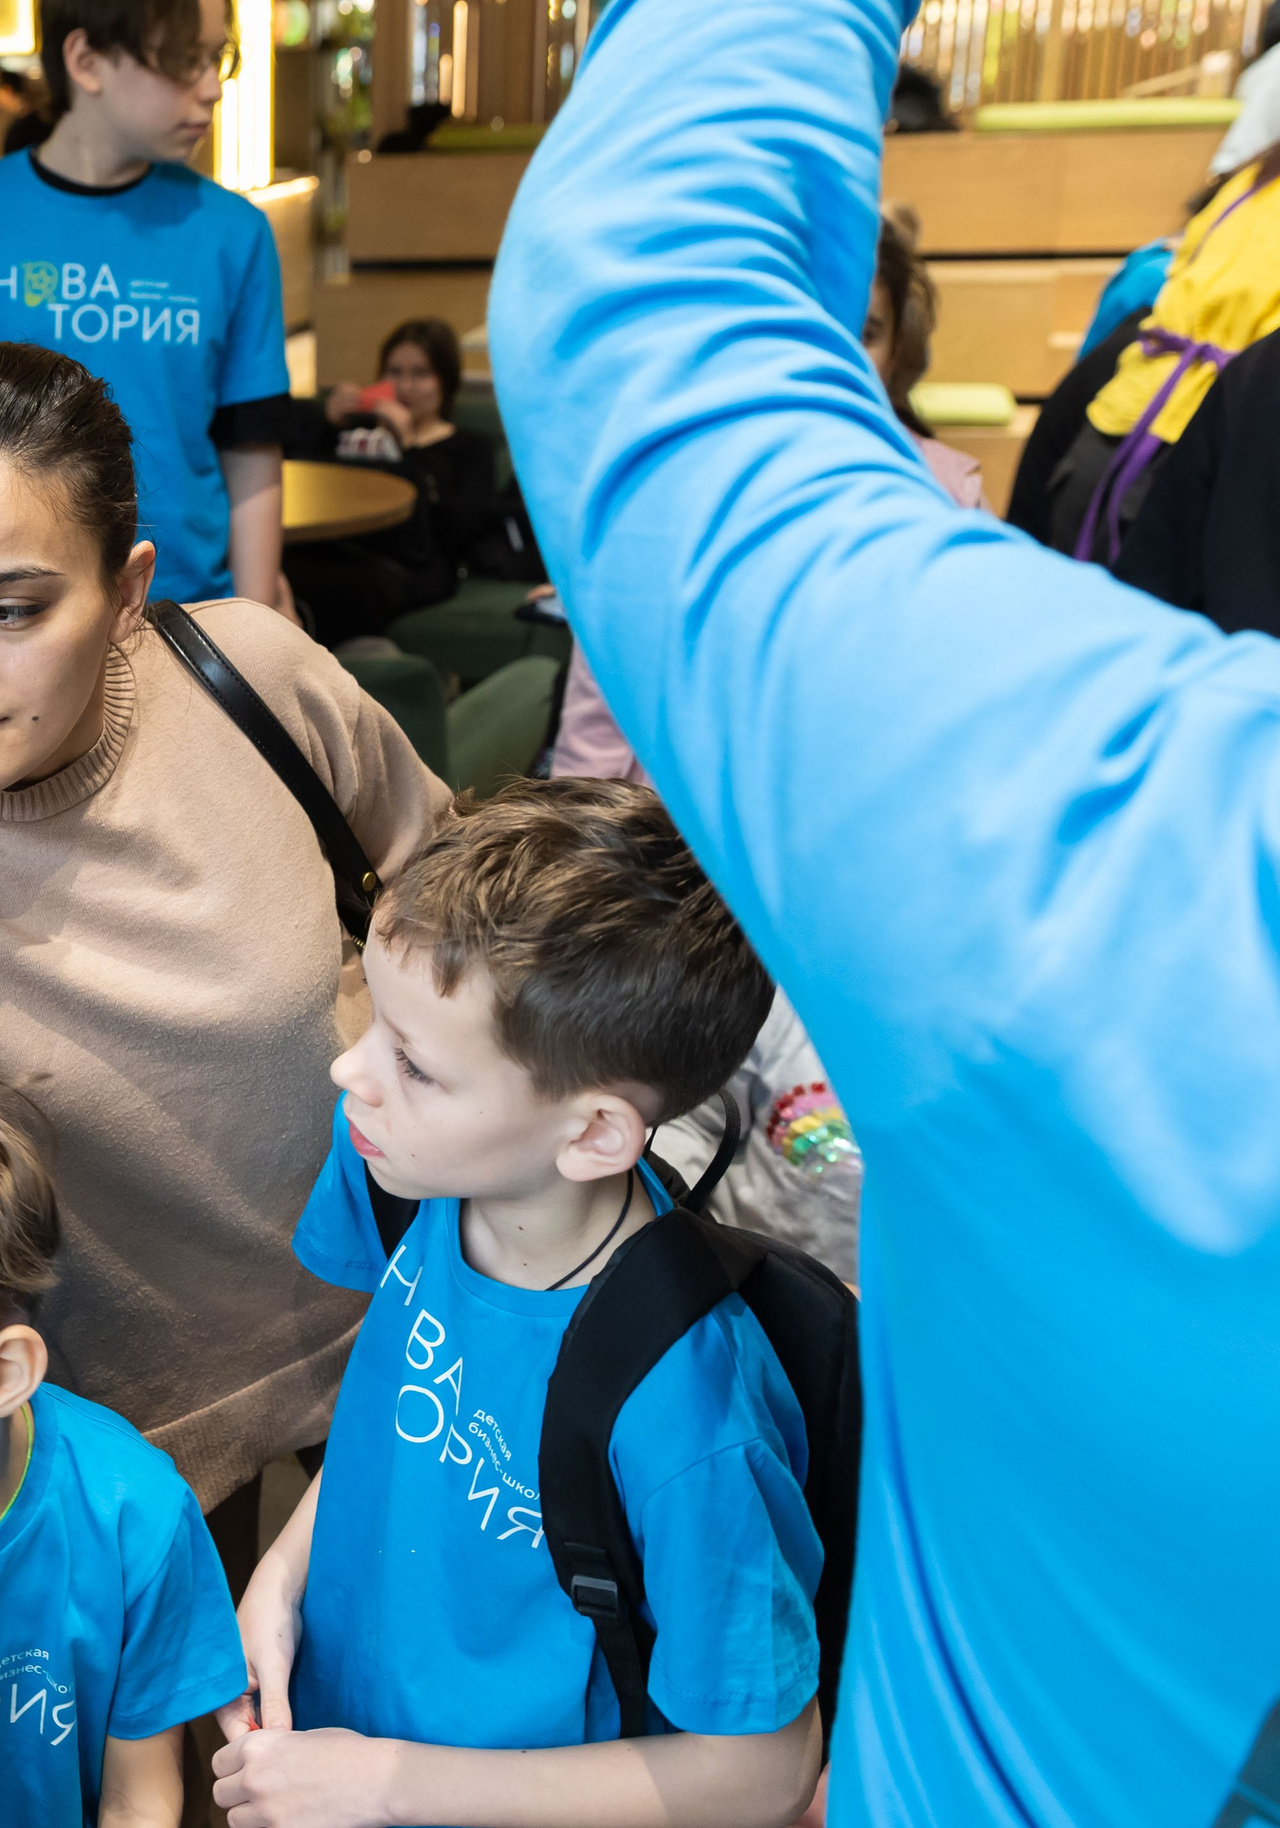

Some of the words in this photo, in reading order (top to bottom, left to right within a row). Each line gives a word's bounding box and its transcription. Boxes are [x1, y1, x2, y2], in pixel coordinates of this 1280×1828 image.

[47, 303, 200, 345] ТОРИЯ
[395, 1384, 545, 1549] ОРИЯ
[468, 1421, 540, 1501] бизнес-шко
[473, 1409, 512, 1461] детская
